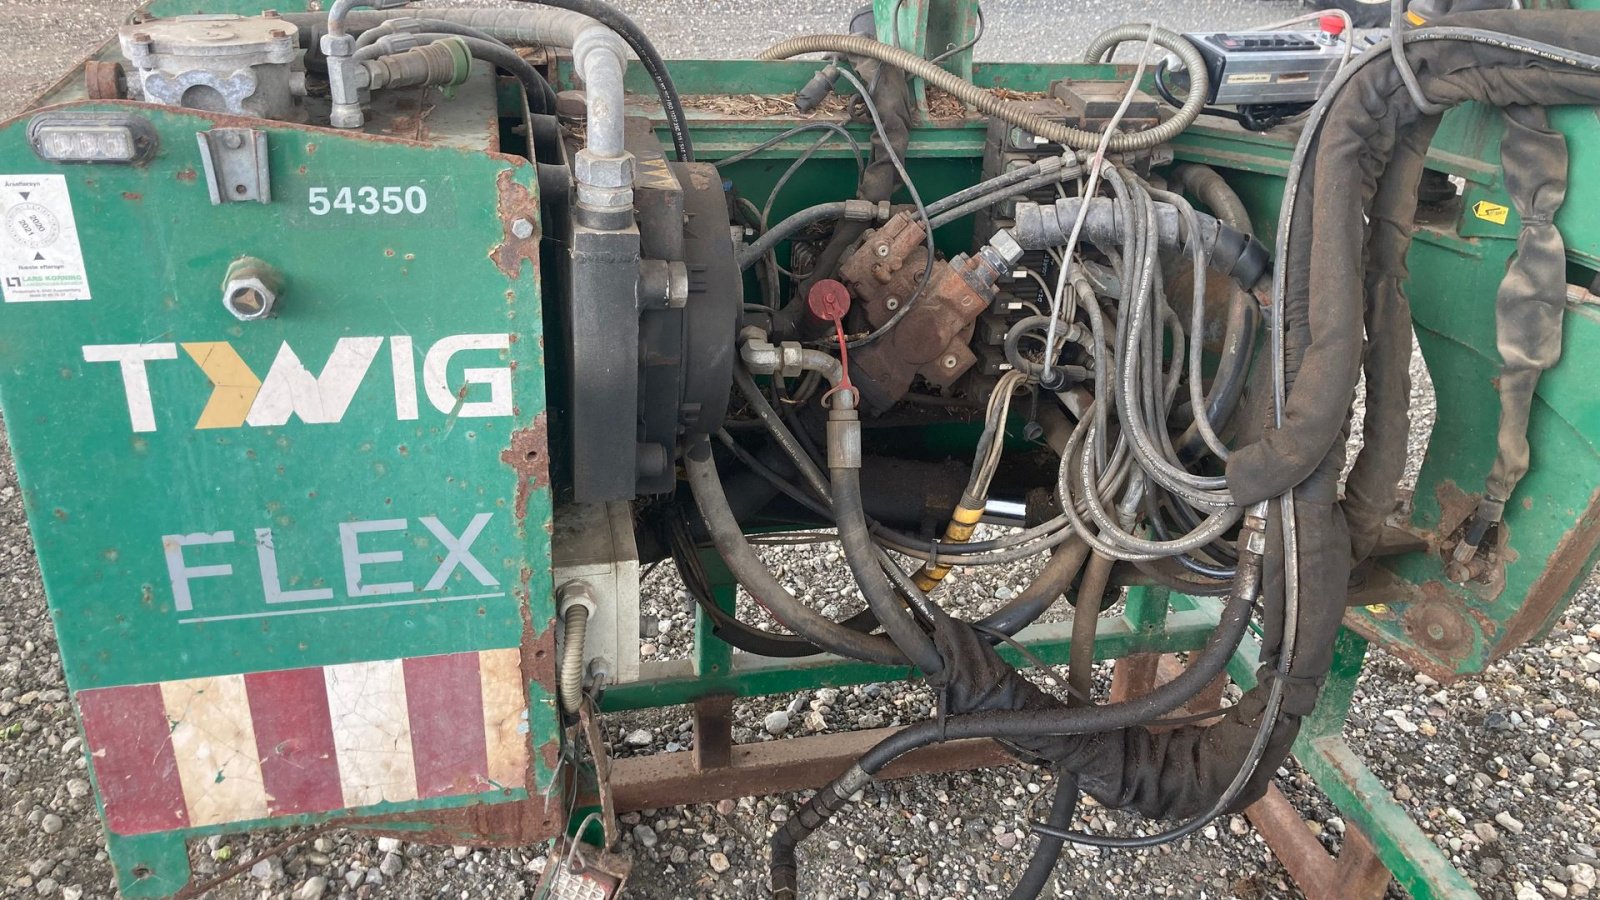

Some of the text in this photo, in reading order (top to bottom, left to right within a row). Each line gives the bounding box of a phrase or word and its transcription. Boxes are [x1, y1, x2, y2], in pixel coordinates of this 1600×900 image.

[308, 186, 427, 215] 54350
[18, 219, 35, 236] 2021
[29, 214, 46, 232] 2020
[82, 333, 513, 432] TWIG
[162, 512, 500, 611] FLEX
